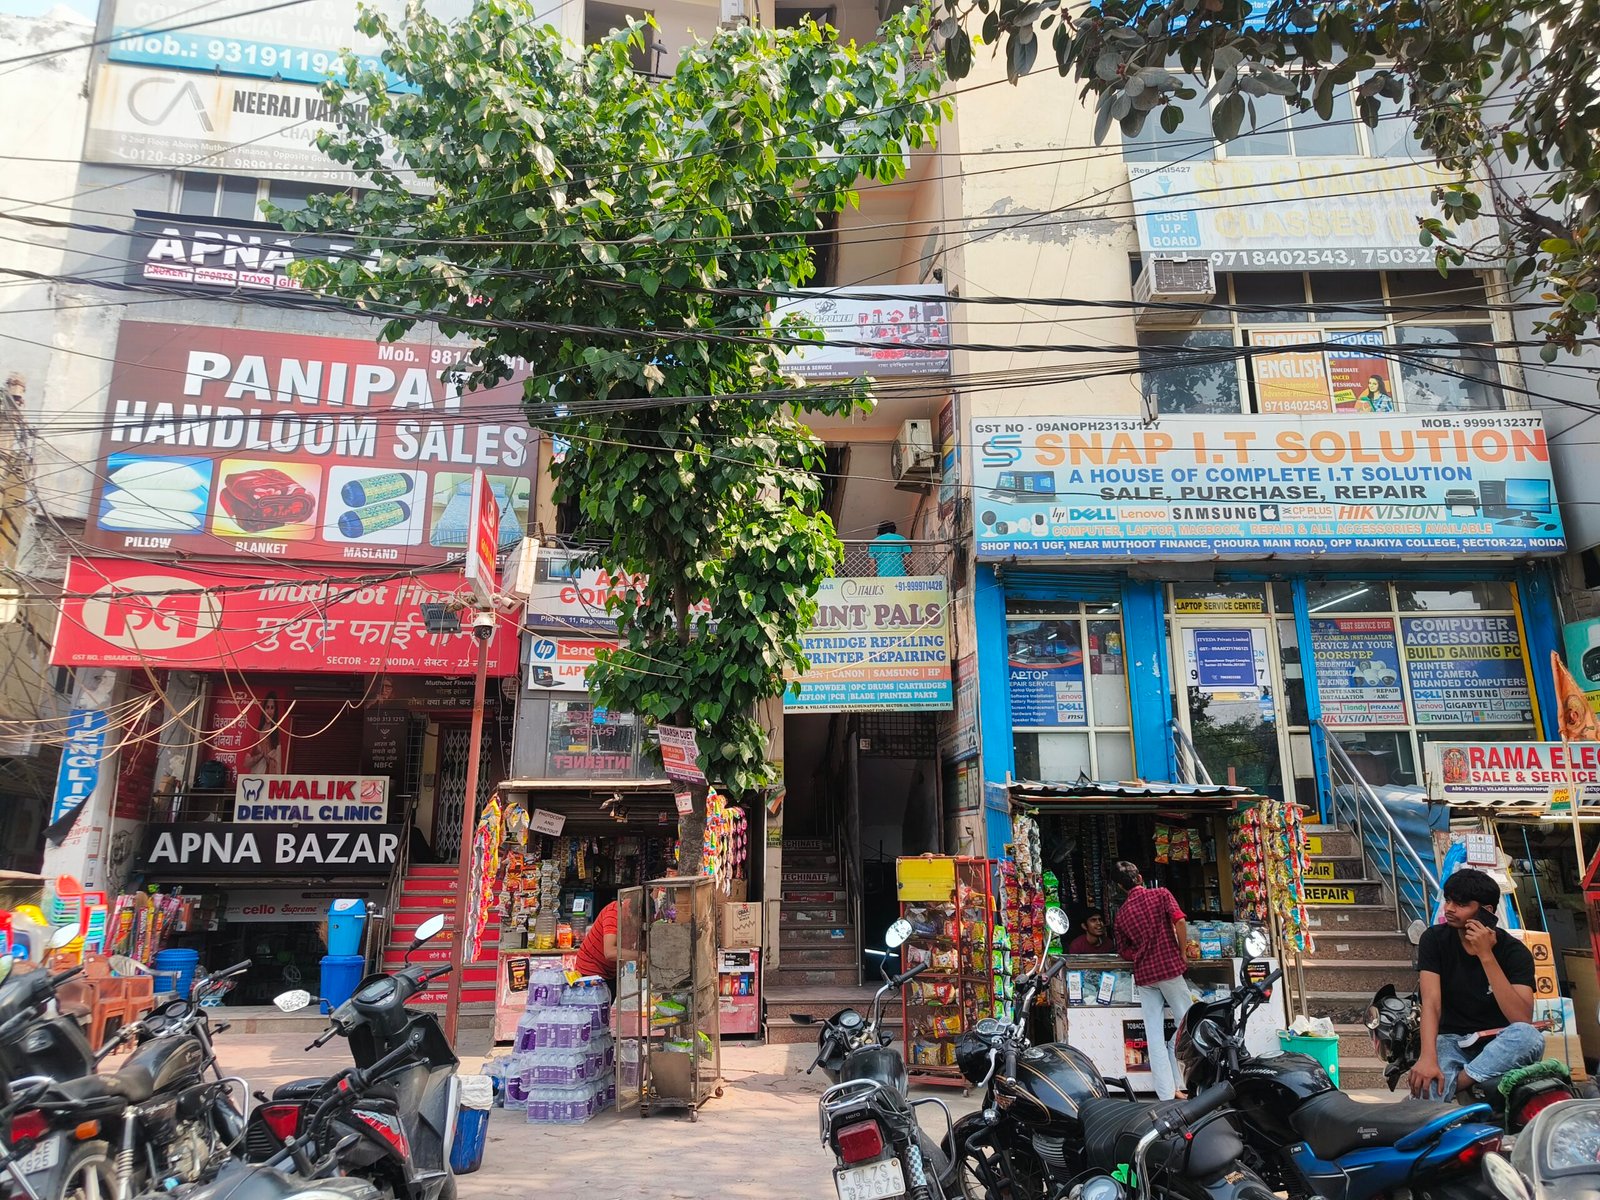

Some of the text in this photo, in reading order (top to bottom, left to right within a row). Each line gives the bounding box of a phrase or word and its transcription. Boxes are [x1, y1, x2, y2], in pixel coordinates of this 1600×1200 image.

[119, 31, 198, 58] Mob.:
[232, 90, 300, 119] NEERAJ
[1155, 212, 1188, 221] CBSE
[1160, 223, 1186, 234] U.P.
[1153, 236, 1197, 247] BOARD
[147, 228, 297, 271] APNA
[1211, 249, 1356, 268] 9718402543,
[242, 274, 271, 285] TOYS
[378, 345, 420, 363] Mob.
[1259, 358, 1325, 379] ENGLISH
[184, 350, 472, 414] PANIPAT
[1264, 400, 1329, 411] 9718402543
[975, 424, 1001, 433] GST
[1005, 423, 1024, 433] NO
[1422, 418, 1460, 428] MOB.:
[1464, 417, 1542, 428] 9999132377
[110, 399, 528, 467] HANDLOOM SALES
[1035, 429, 1549, 466] SNAP I.T SOLUTION
[1069, 466, 1473, 483] A HOUSE OF COMPLETE I.T SOLUTION
[1100, 485, 1427, 502] SALE, PURCHASE, REPAIR
[1052, 504, 1440, 522] hp DELL Lenovo SAMSUNG CP PLUS HIKVISION
[1052, 523, 1493, 537] COMPUTER, LAPTOP, MACBOOK, REPAIR ALL ACCESSORIES AVAILABLE
[125, 536, 172, 549] PILLOW
[235, 541, 288, 555] BLANKET
[981, 538, 1565, 551] SHOP NO.1 UGF, NEAR MUTHOOT FINANCE, CHOURA MAIN ROAD, OPP RAJKIYA COLLEGE, SECTOR-22, NOIDA
[343, 546, 399, 560] MASLAND
[258, 579, 387, 605] Muthoot
[1176, 602, 1261, 610] LAPTOP SERVICE CENTRE
[873, 603, 944, 629] PALS
[1340, 621, 1391, 630] BEST SERVICE EVER
[1410, 618, 1509, 632] COMPUTER
[870, 635, 945, 650] REFILLING
[1351, 641, 1394, 649] AT YOUR
[1406, 631, 1519, 645] ACCESSORIES
[804, 650, 946, 664] PRINTER REPAIRING
[1407, 645, 1521, 659] BUILD GAMING PC
[326, 656, 415, 667] SECTOR 22 NOIDA
[1410, 661, 1455, 671] PRINTER
[831, 668, 941, 678] CANON SAMSUNG HP
[1411, 670, 1479, 679] WIFI CAMERA
[814, 681, 947, 691] POWDER DRUMS CARTRIDGES
[1327, 678, 1350, 686] KINDS
[1413, 677, 1527, 688] BRANDED COMPUTERS
[799, 691, 938, 702] TEFLON BLADE PRINTER PARTS
[1414, 689, 1499, 699] DELL SAMSUNG
[1446, 701, 1489, 709] GIGABYTE
[1486, 712, 1522, 720] Microsoft
[1468, 746, 1543, 770] RAMA
[1472, 771, 1511, 783] SALE
[1515, 771, 1527, 783] &
[268, 779, 357, 801] MALIK
[237, 805, 383, 821] DENTAL CLINIC
[148, 831, 399, 864] APNA BAZAR
[1304, 888, 1350, 900] REPAIR
[243, 903, 318, 915] cello Supreme
[845, 1112, 861, 1120] Hero
